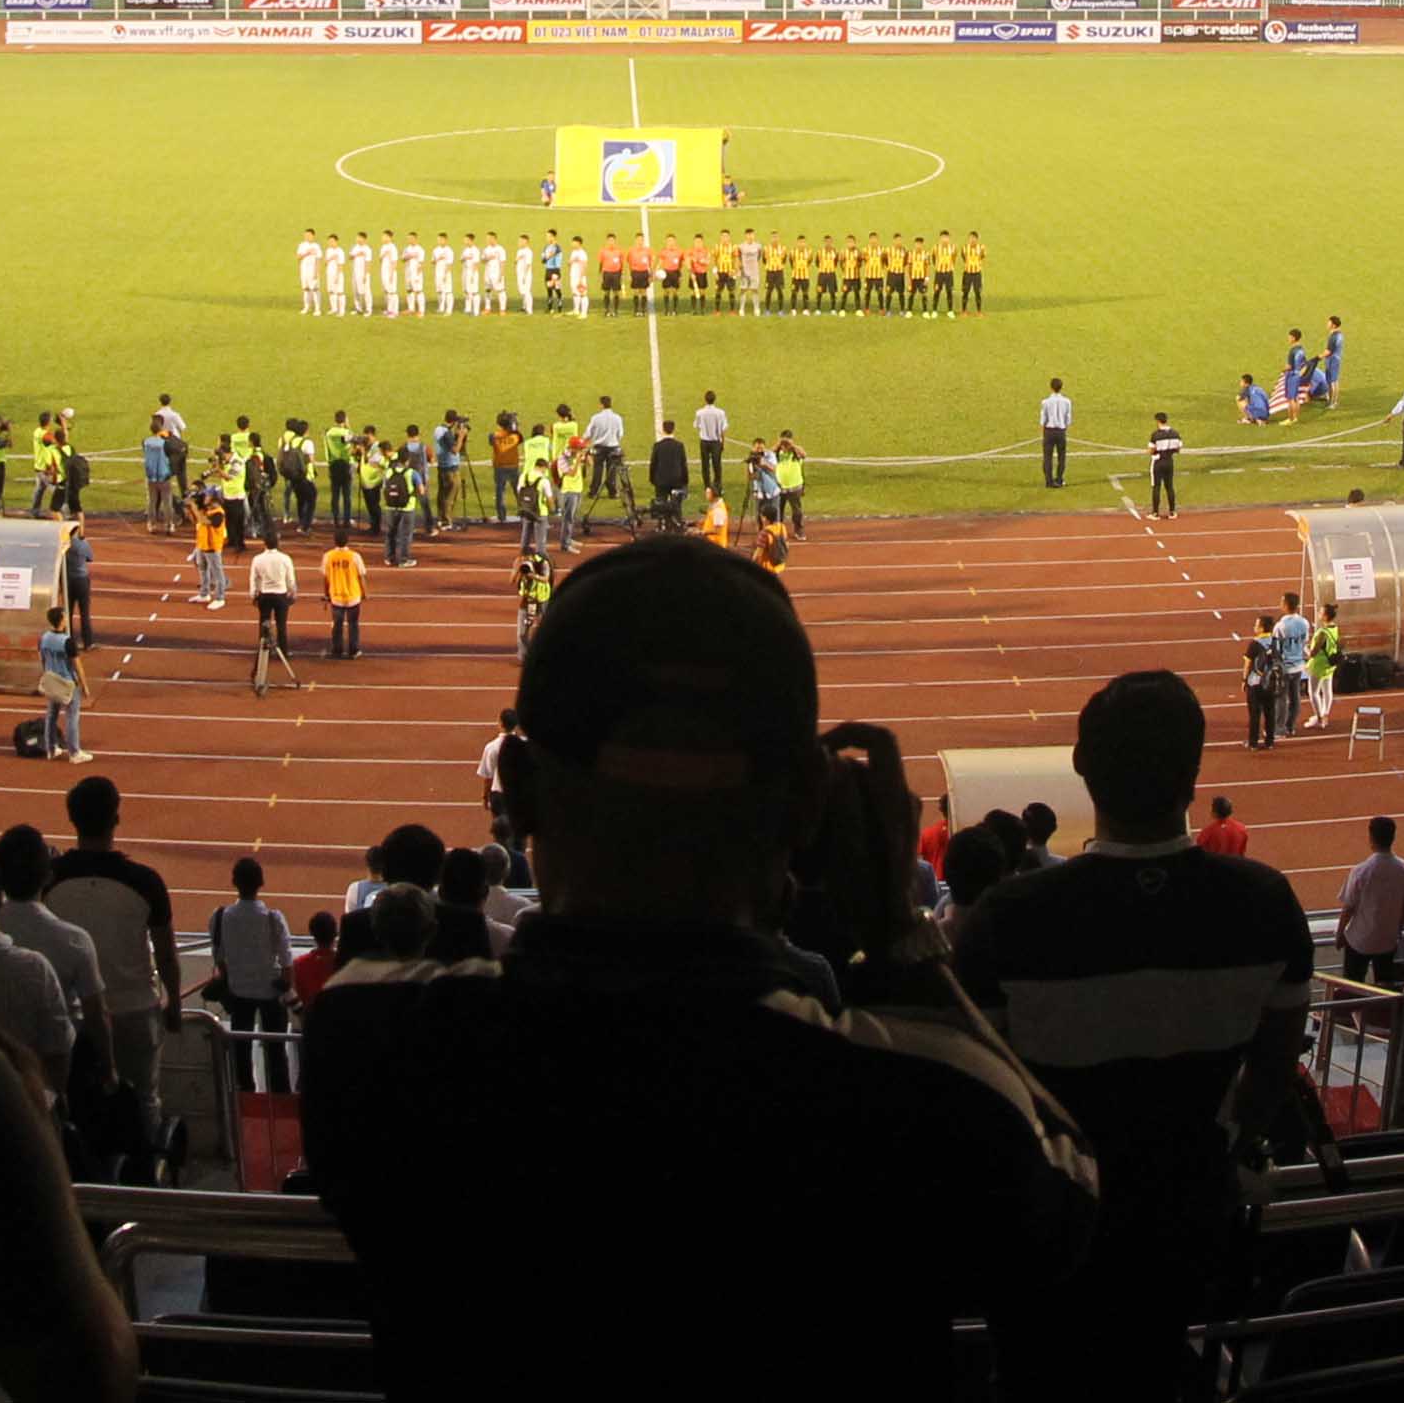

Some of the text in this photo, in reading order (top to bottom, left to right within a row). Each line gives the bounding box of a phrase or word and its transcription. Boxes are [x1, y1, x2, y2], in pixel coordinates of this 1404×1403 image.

[129, 24, 211, 39] www.vff.org.vn
[238, 27, 312, 38] YANMAR
[344, 26, 414, 38] SUZUKI
[427, 23, 523, 41] Z.com
[601, 27, 628, 37] NAM
[680, 27, 735, 37] MALAYSIA
[748, 23, 843, 41] Z.com
[876, 26, 951, 37] YANMAR
[958, 27, 1054, 36] GRAND SPORT
[1086, 26, 1154, 38] SUZUKI
[1163, 23, 1258, 37] sportradar
